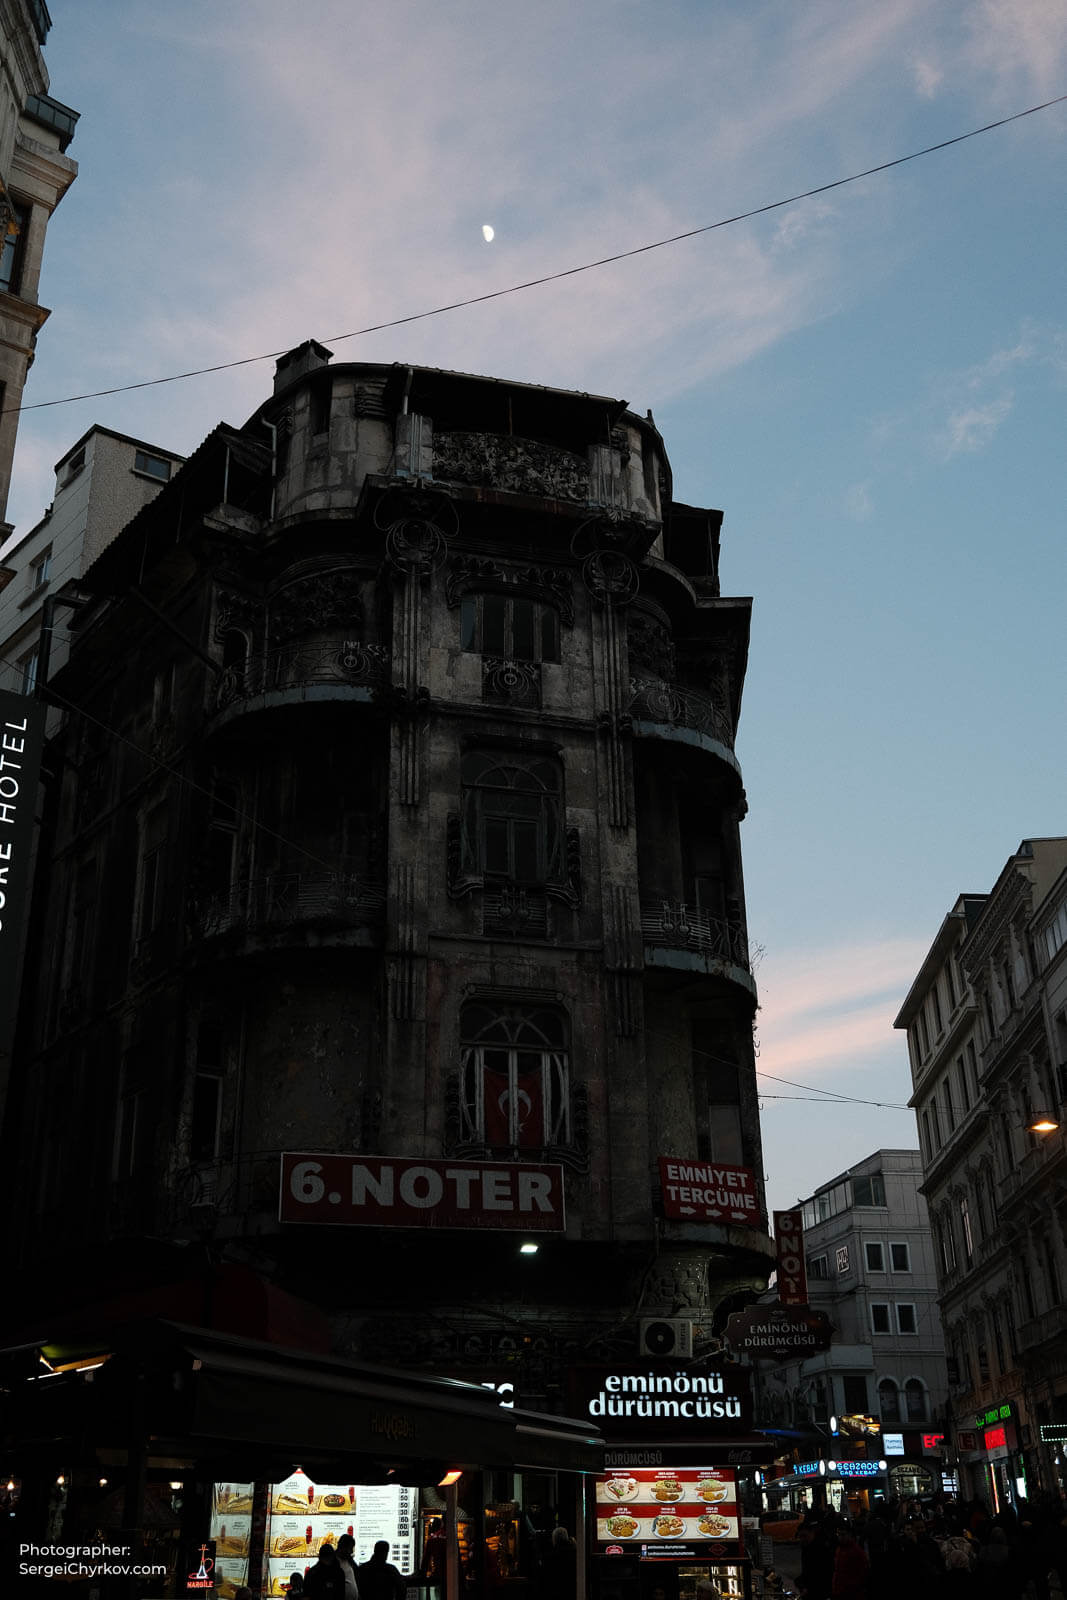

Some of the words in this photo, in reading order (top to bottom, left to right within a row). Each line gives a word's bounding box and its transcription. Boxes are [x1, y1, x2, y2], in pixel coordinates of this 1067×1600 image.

[0, 718, 28, 824] HOTEL
[351, 1164, 554, 1213] NOTER
[666, 1165, 748, 1188] EMNİYET
[666, 1185, 756, 1210] TERCÜME
[750, 1322, 808, 1335] EMİNÖNÜ
[744, 1335, 816, 1347] DÜRÜMCÜSÜ
[604, 1371, 724, 1394] eminönü
[588, 1392, 741, 1418] dürümcüsü
